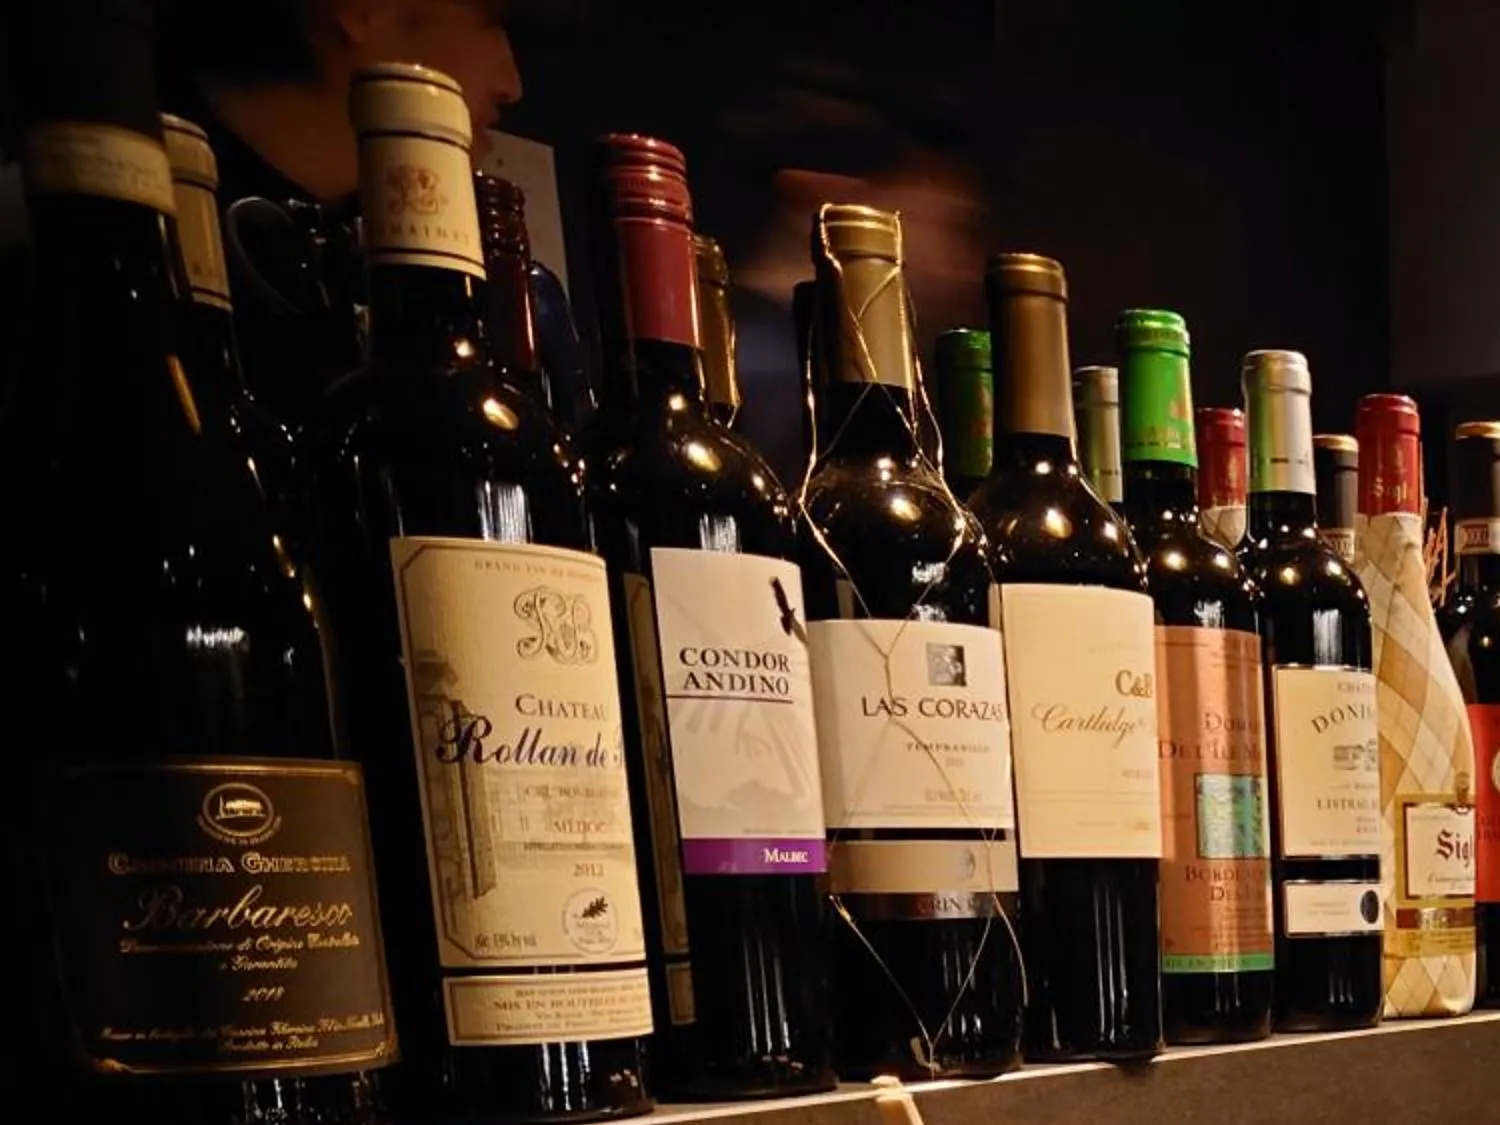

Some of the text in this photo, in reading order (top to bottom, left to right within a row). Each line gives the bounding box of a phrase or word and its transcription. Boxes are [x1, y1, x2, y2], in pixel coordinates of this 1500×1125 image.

[679, 647, 790, 673] CONDOR
[683, 671, 790, 697] ANDINO
[861, 697, 908, 718] LAS
[434, 712, 577, 767] Rollan
[121, 883, 353, 931] Barbaresco
